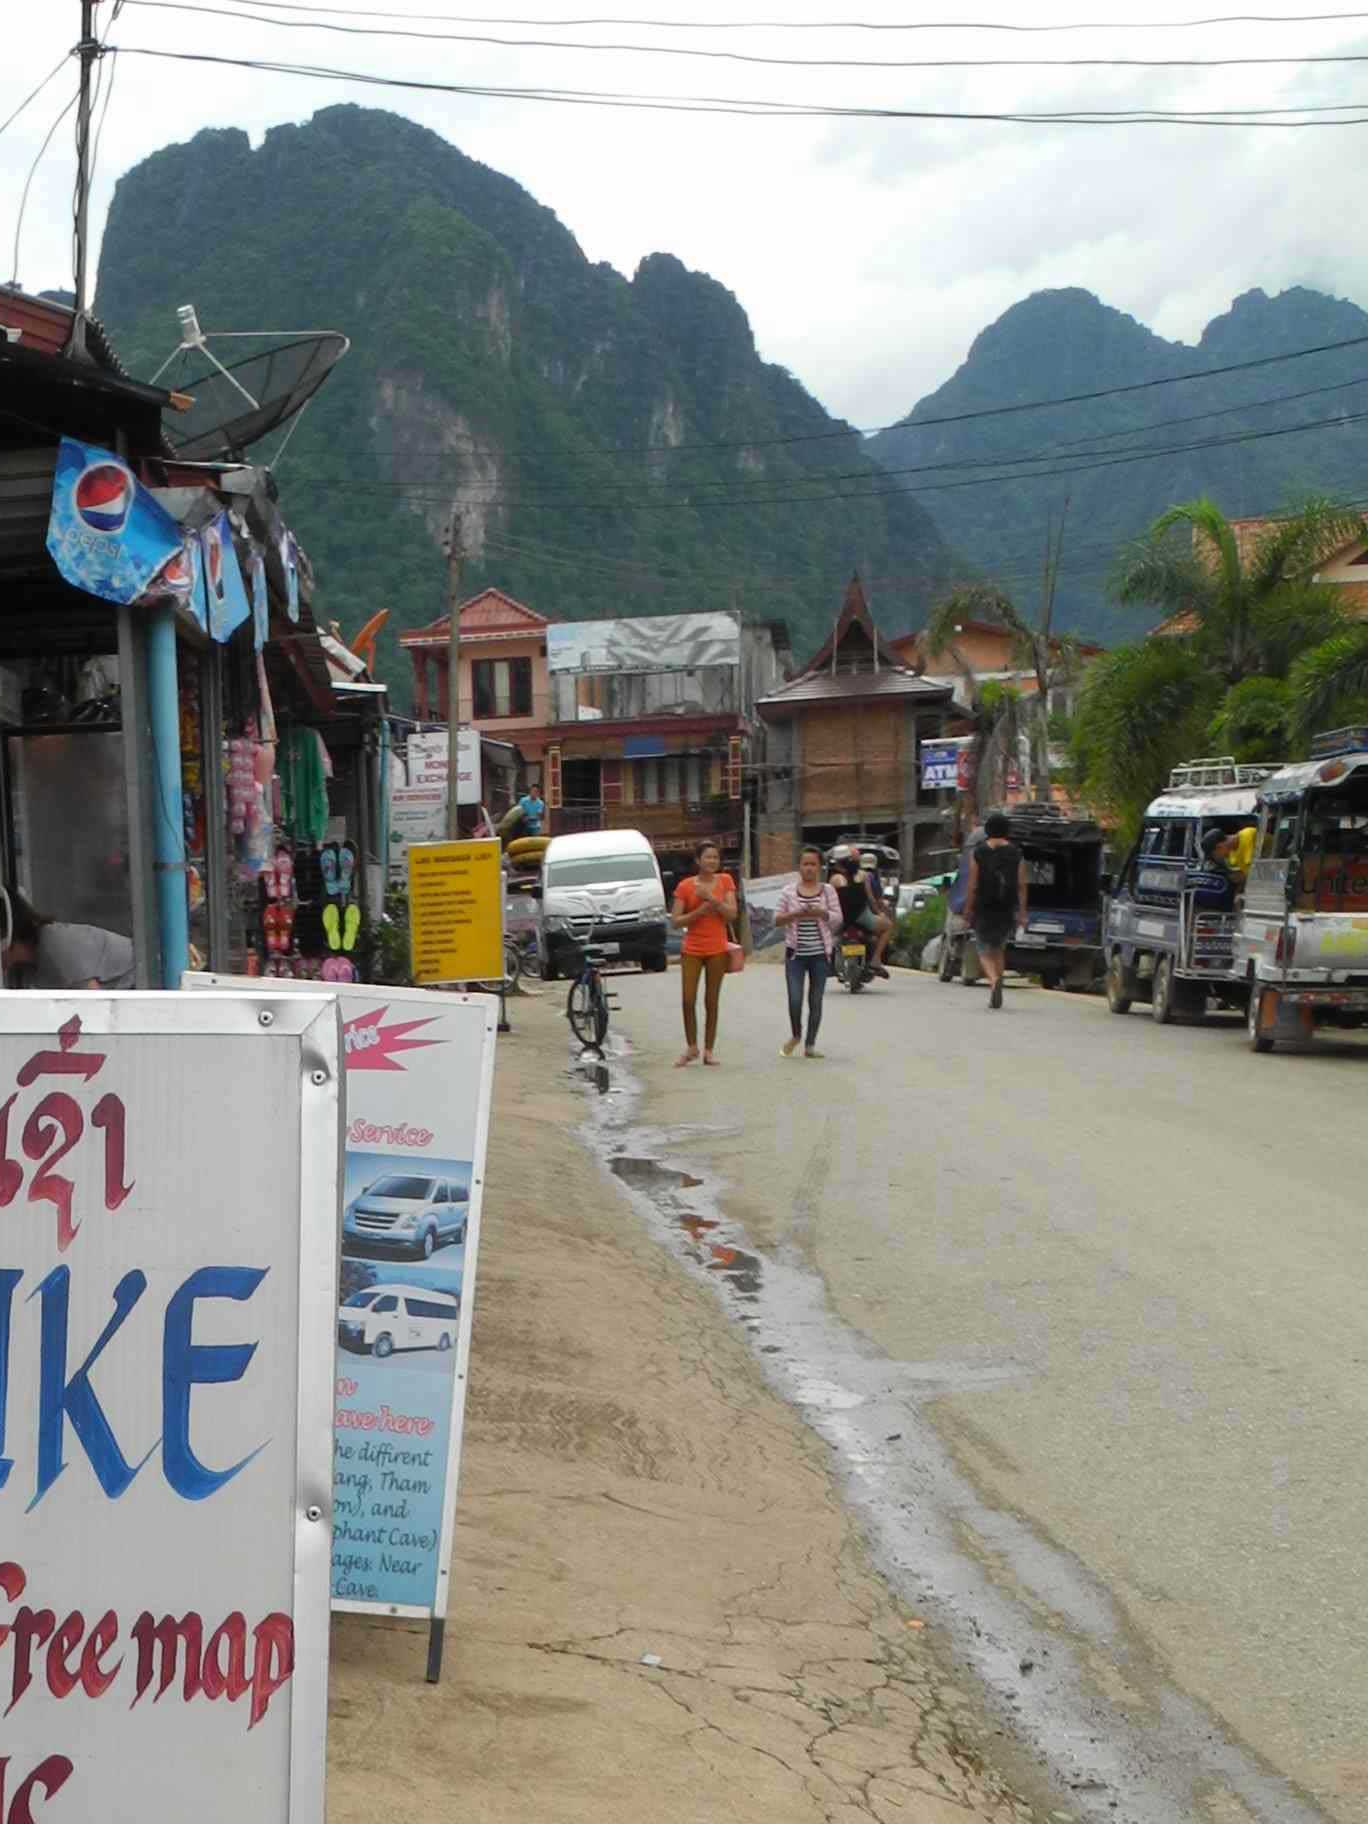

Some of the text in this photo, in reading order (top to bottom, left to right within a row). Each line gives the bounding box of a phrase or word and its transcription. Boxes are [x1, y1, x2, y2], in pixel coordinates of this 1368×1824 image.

[350, 1118, 434, 1148] Service
[378, 1403, 436, 1437] here
[371, 1499, 409, 1519] and
[388, 1527, 438, 1553] Cave)
[379, 1551, 424, 1576] Near
[131, 1608, 296, 1730] map
